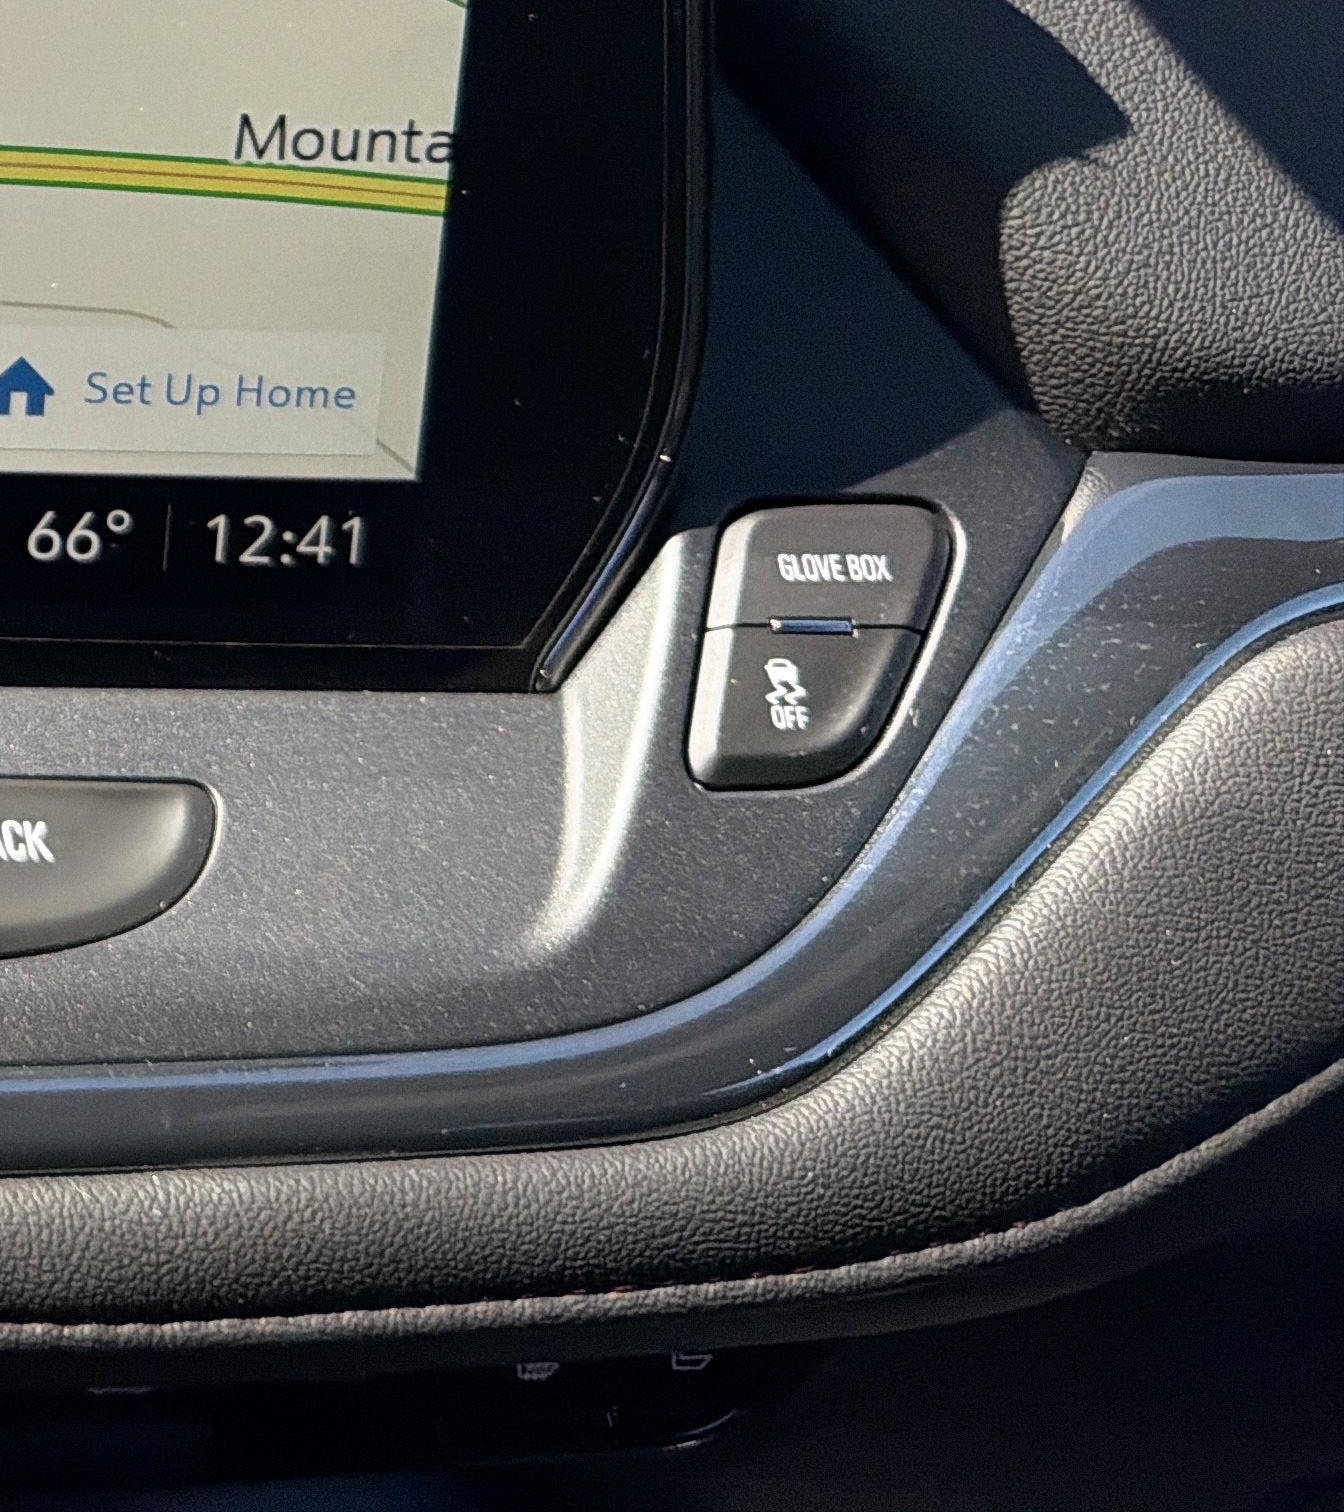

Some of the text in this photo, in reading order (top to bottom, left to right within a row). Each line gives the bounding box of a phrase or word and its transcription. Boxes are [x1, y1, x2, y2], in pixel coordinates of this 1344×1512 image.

[234, 112, 456, 164] Mounta
[84, 371, 357, 416] Set Up Home
[206, 513, 364, 567] 12:41
[777, 553, 893, 582] GLOVE BOX
[770, 704, 810, 730] OFF
